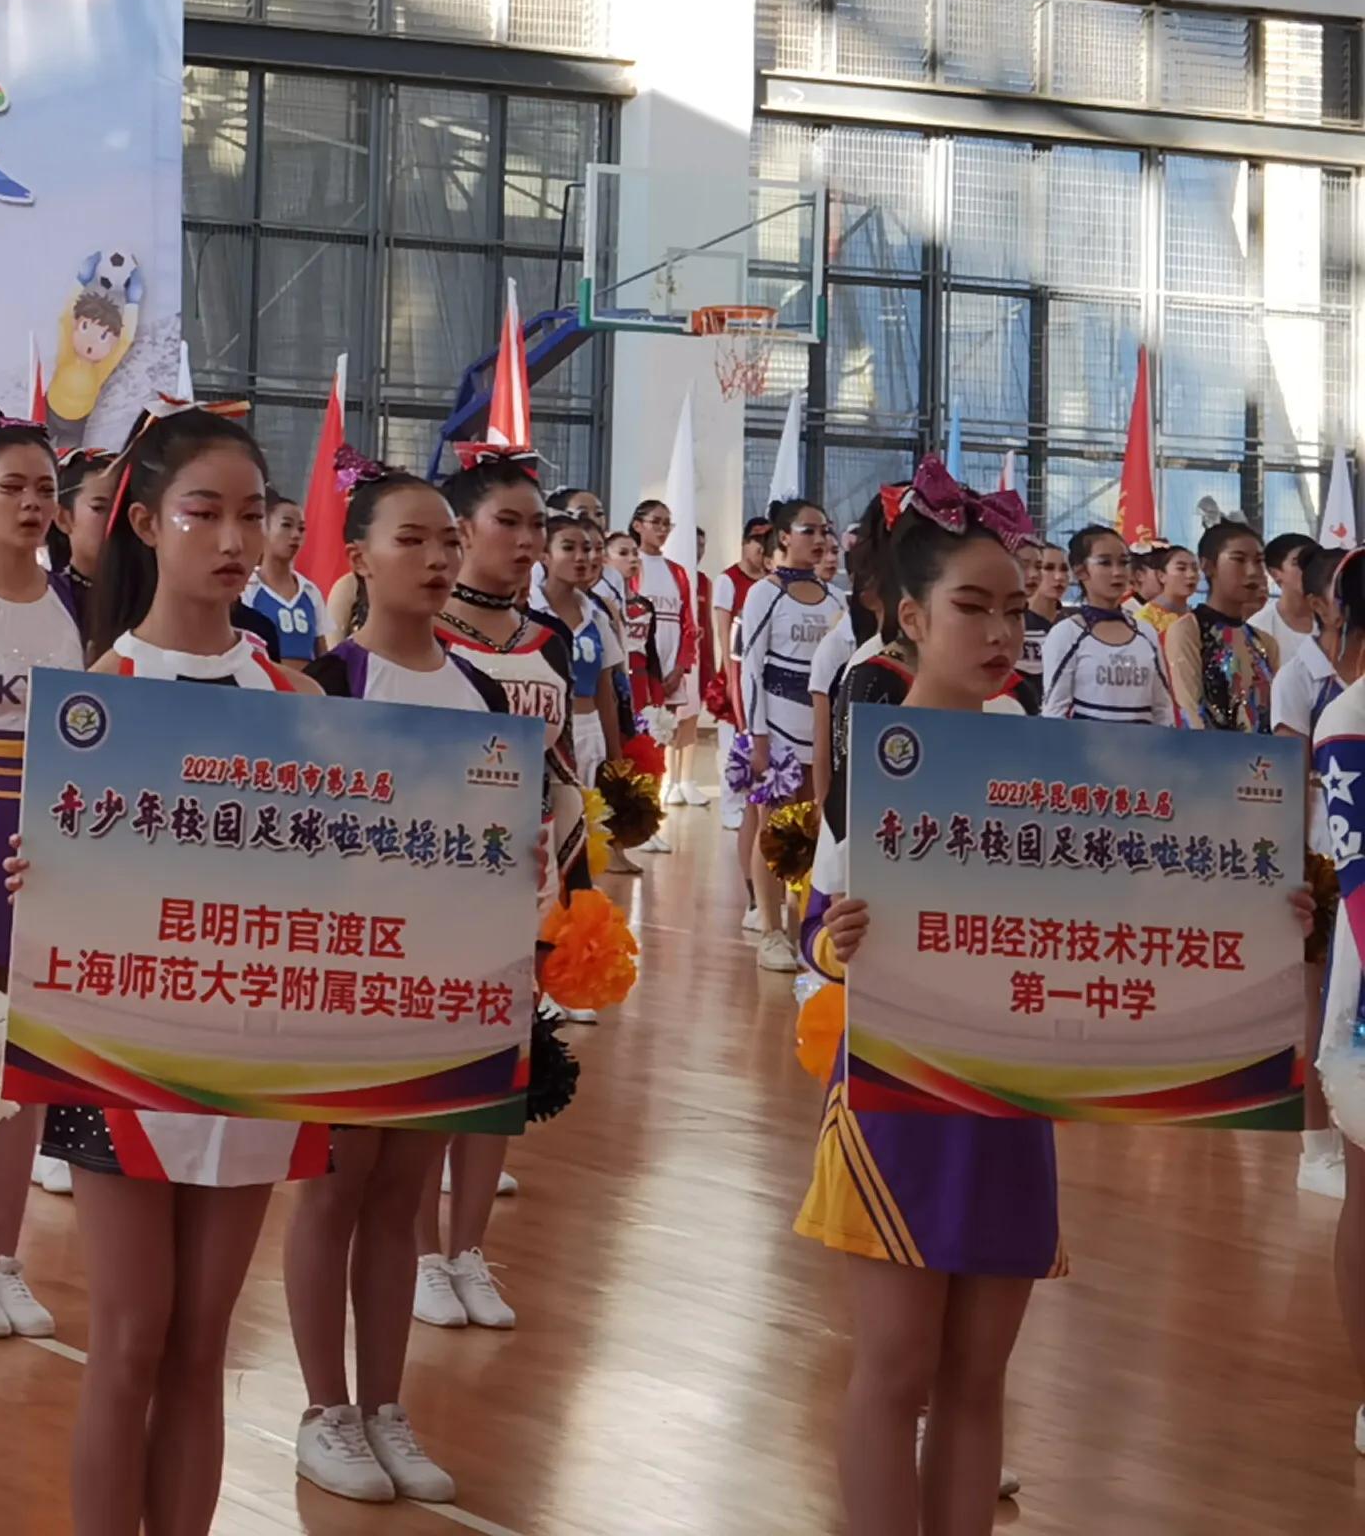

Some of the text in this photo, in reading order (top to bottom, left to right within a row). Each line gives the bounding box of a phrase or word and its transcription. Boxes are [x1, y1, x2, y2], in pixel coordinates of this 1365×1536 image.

[181, 754, 396, 804] 2021年昆明市第五届
[986, 779, 1174, 821] 2021年昆明市第五届
[51, 780, 515, 875] 青少年校园足球啦啦操比赛
[874, 809, 1284, 883] 青少年校园足球啦啦操比赛
[157, 897, 407, 960] 昆明市官渡区
[917, 911, 1246, 971] 昆明经济技术开发区
[32, 947, 514, 1027] 上海师范大学附属实验学校
[1010, 970, 1157, 1020] 第一中学
